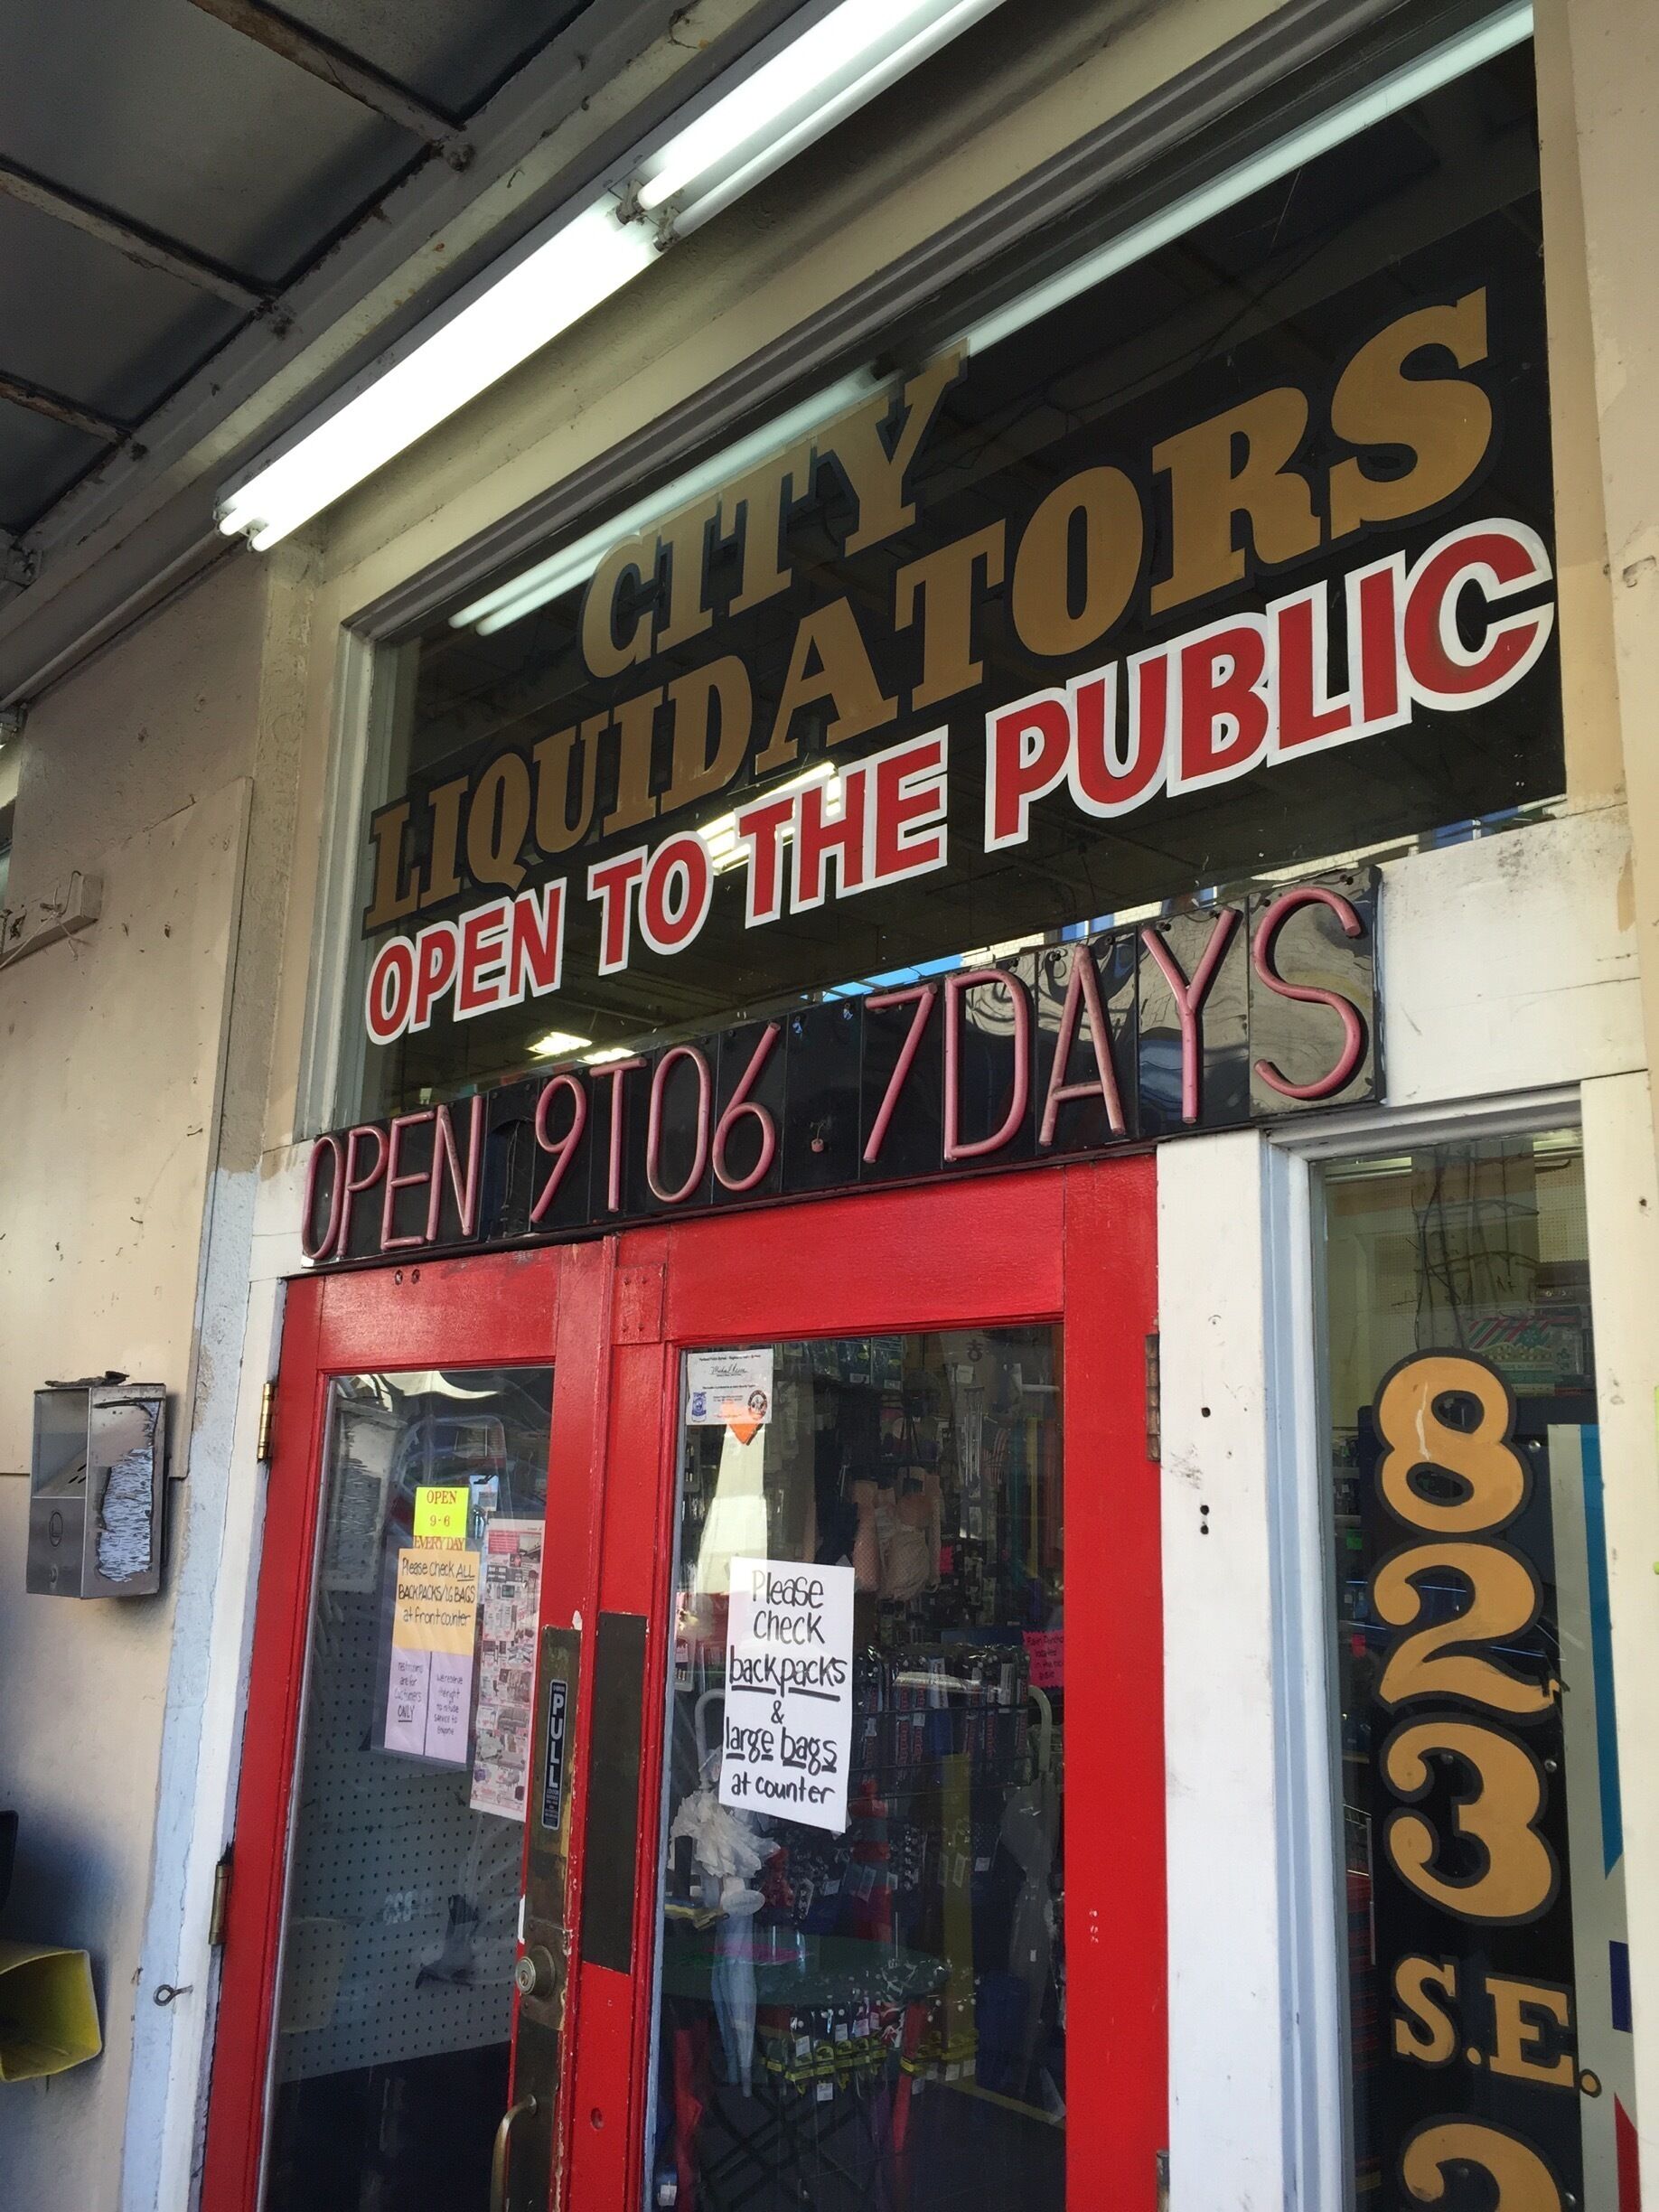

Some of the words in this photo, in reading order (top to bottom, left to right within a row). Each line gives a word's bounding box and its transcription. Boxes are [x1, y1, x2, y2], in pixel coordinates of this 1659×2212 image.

[580, 338, 970, 680] CITY
[365, 286, 1493, 932] LIQUIDATORS
[364, 876, 567, 1045] OPEN
[586, 830, 714, 976] TO
[733, 725, 950, 930] THE
[984, 517, 1555, 854] PUBLIC
[301, 1093, 483, 1261] OPEN
[426, 1489, 457, 1504] OPEN
[402, 1557, 427, 1576] Please
[456, 1563, 475, 1579] ALL
[752, 1569, 824, 1609] Please
[403, 1606, 413, 1623] at
[415, 1606, 440, 1624] front
[440, 1609, 472, 1626] counter
[455, 1585, 476, 1604] BAGS
[1372, 1354, 1561, 1919] 823
[728, 1645, 848, 1699] backpacks
[398, 1704, 416, 1719] ONLY
[770, 1700, 785, 1725] &
[548, 1692, 565, 1789] PULL
[725, 1716, 774, 1763] large
[780, 1726, 839, 1776] bags
[730, 1771, 751, 1796] at
[755, 1775, 836, 1804] counter
